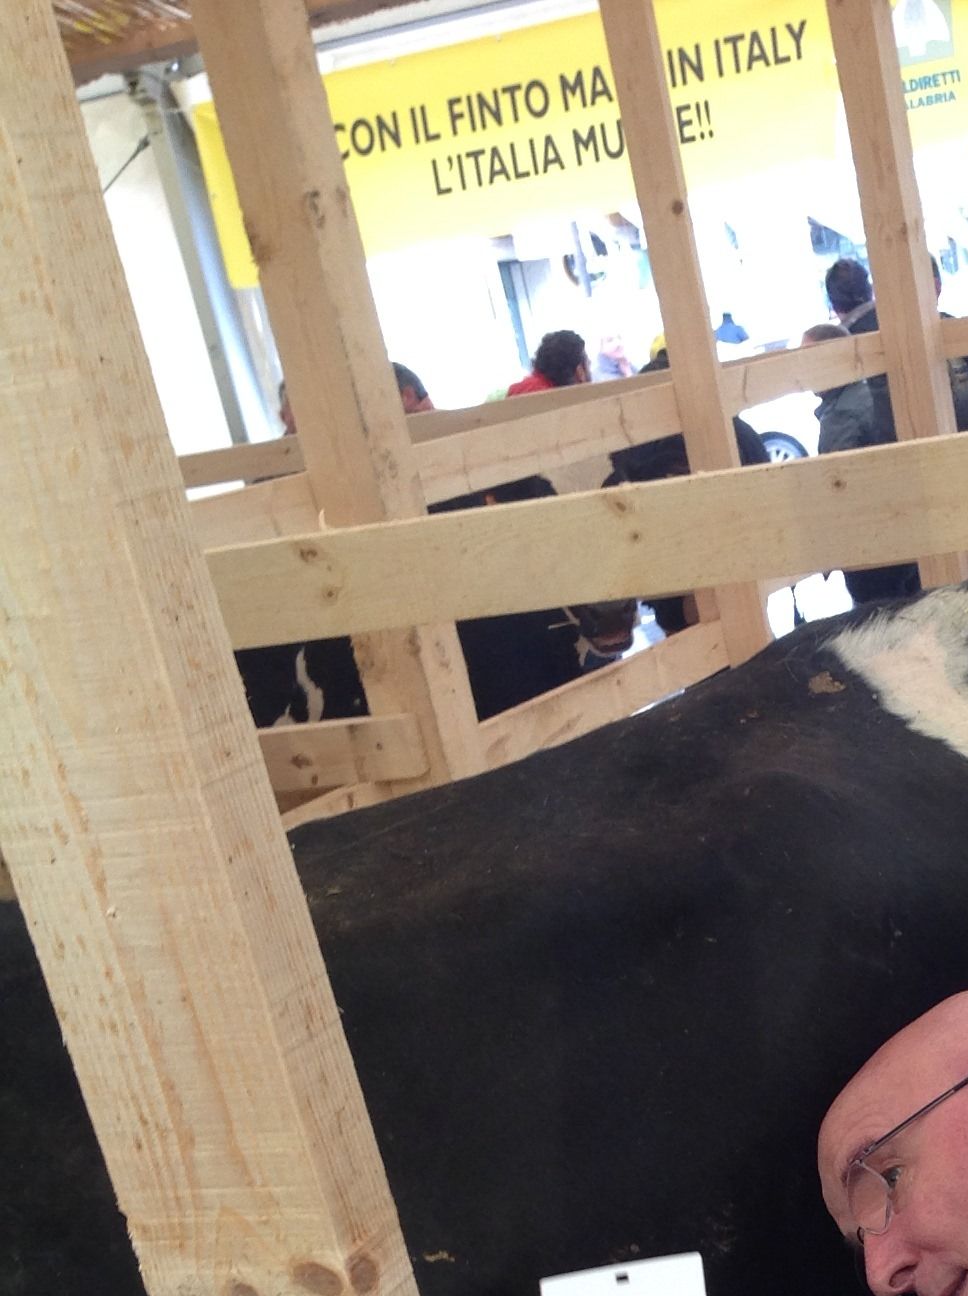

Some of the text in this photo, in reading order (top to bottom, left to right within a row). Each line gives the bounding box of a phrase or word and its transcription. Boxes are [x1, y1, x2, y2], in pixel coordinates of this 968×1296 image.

[410, 103, 441, 145] IL
[447, 79, 550, 137] FINTO
[559, 65, 614, 112] MA
[667, 43, 705, 88] IN
[714, 19, 807, 78] ITALY
[902, 69, 961, 94] LDIRETTI
[431, 134, 566, 196] L'ITALIA
